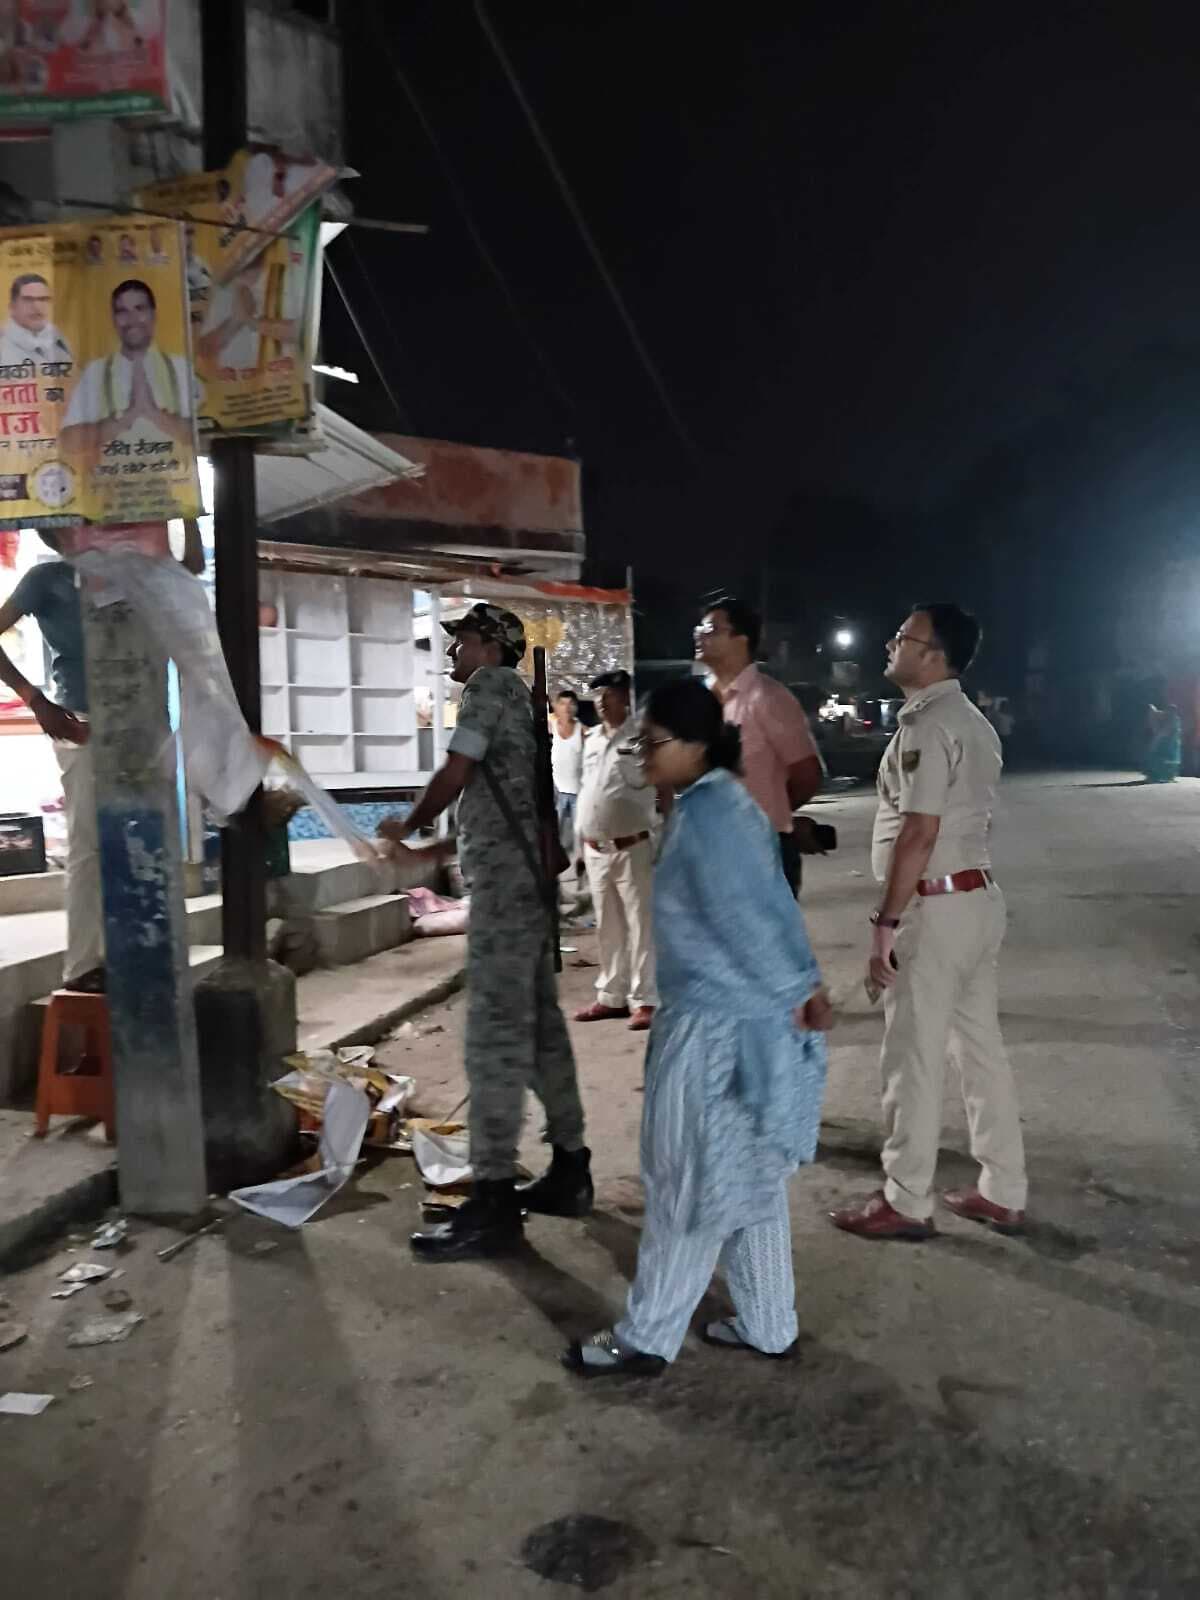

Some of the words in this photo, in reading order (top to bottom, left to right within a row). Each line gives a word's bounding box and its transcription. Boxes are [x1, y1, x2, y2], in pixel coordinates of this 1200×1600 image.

[0, 358, 35, 379] बकी
[0, 384, 38, 404] नता
[0, 411, 40, 434] ाज
